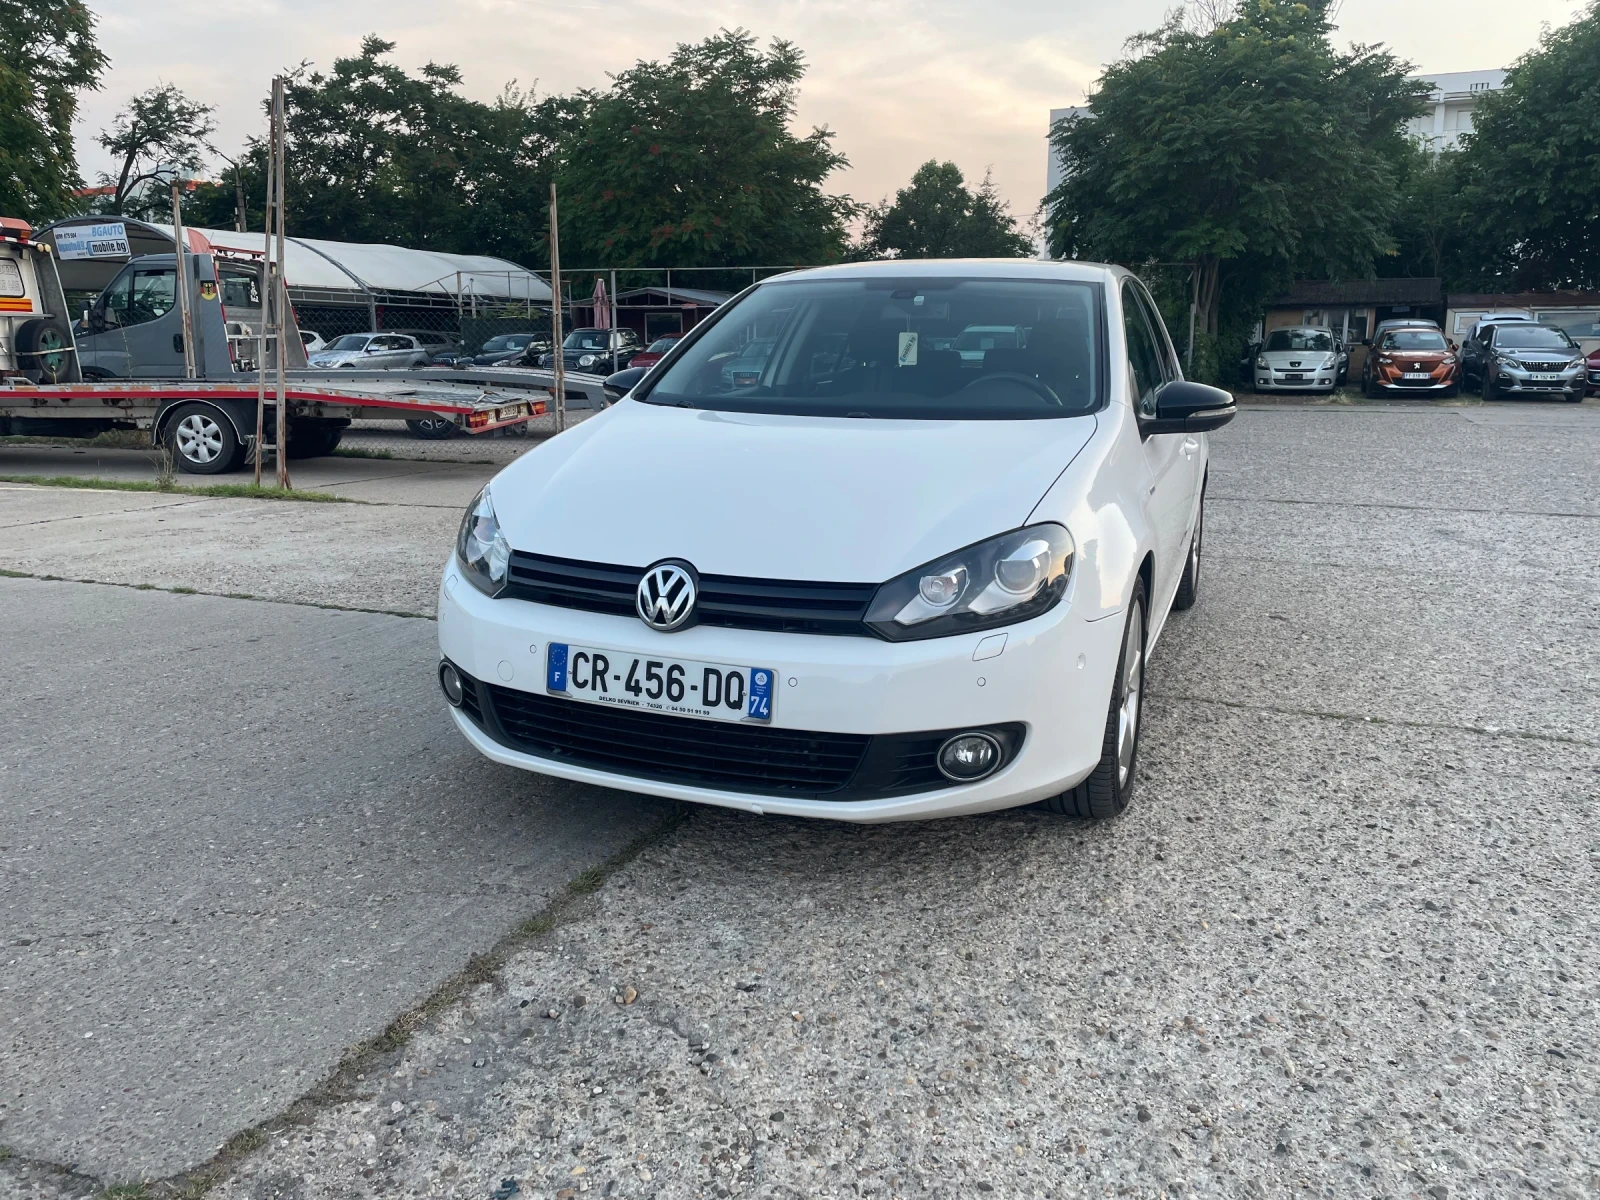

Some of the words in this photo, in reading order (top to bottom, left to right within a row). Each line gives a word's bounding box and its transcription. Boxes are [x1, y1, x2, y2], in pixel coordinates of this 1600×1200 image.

[92, 225, 124, 237] BGAUTO
[554, 672, 561, 682] F
[572, 652, 744, 710] CR-456-DQ
[750, 695, 769, 716] 74
